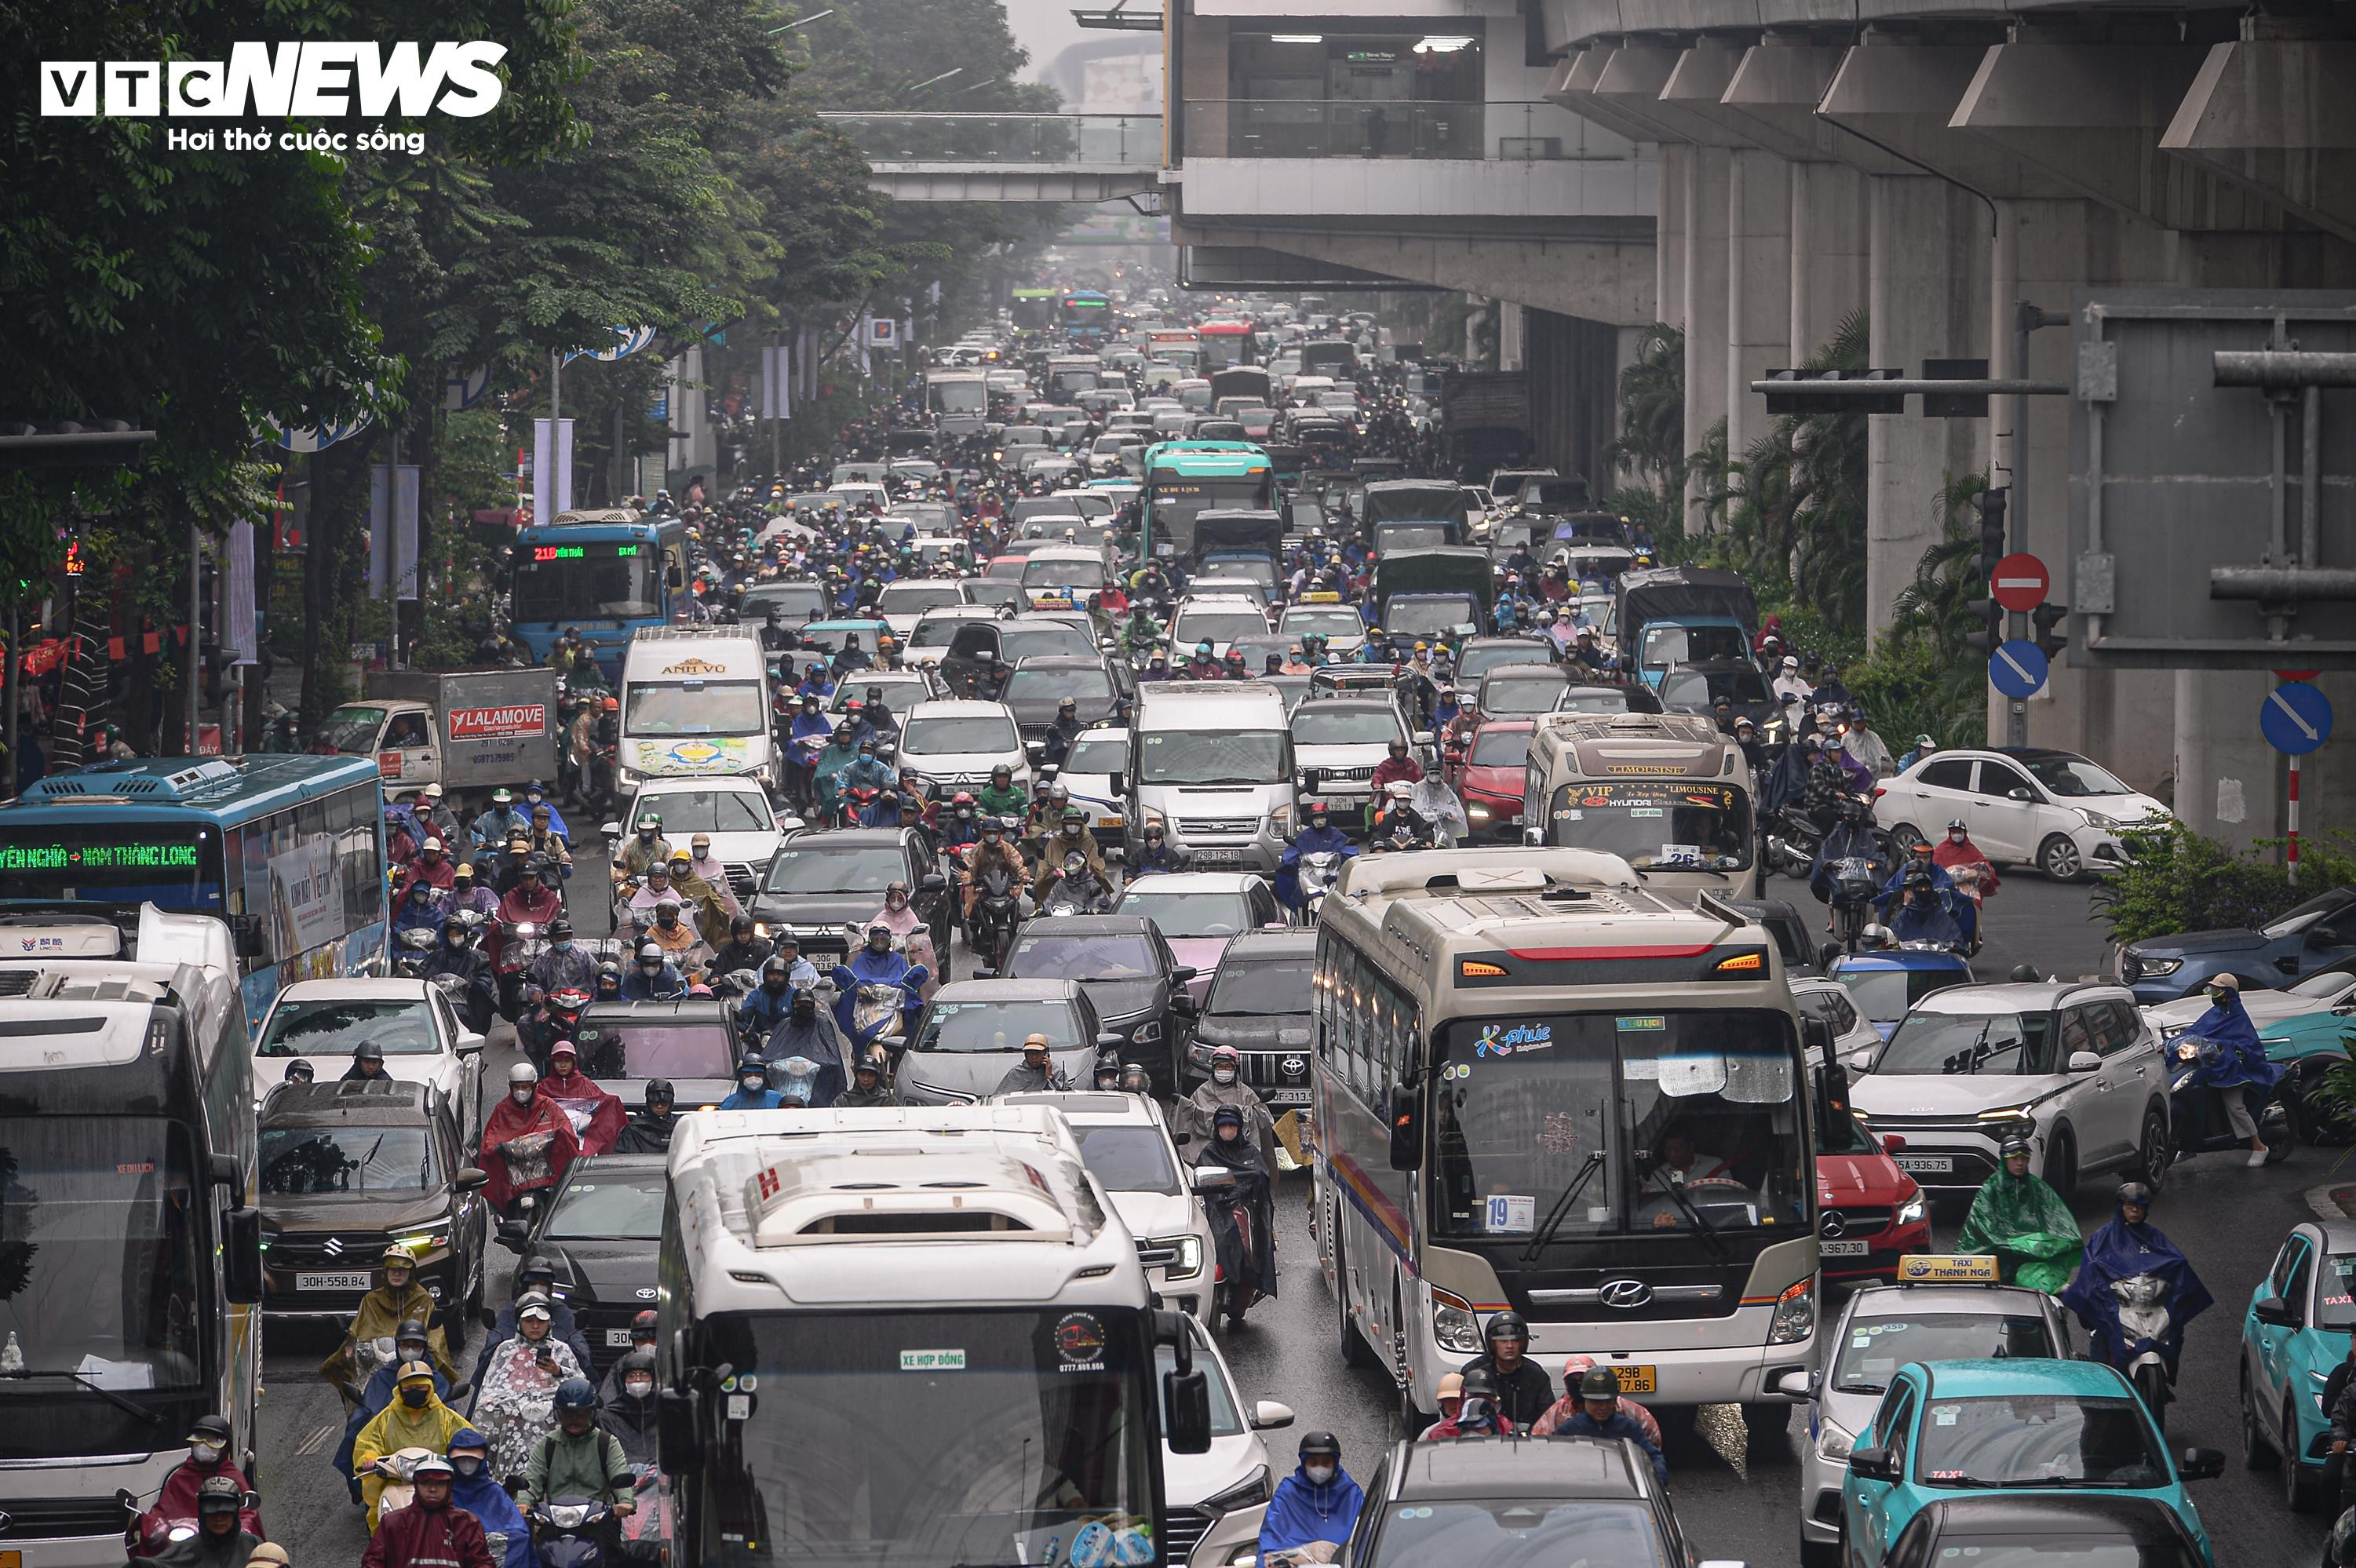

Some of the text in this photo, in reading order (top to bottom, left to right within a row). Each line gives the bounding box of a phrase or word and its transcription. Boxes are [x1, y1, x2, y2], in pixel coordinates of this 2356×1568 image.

[466, 707, 542, 727] LALAMOVE
[1611, 766, 1682, 775] LIMOUSINE
[1586, 786, 1719, 797] VIP LIMOUSINE
[27, 844, 67, 868] NGHĨA
[82, 846, 112, 866] NAM
[115, 842, 159, 866] THĂNG
[161, 845, 196, 866] LONG
[1198, 851, 1238, 860] 29B-125.18
[1671, 852, 1694, 866] 26
[1895, 1161, 1947, 1170] 5A-936.75
[1488, 1198, 1508, 1227] 19
[1934, 1268, 1967, 1277] THANH
[1971, 1267, 1991, 1277] NGA
[302, 1276, 365, 1287] 30H-558.84
[2323, 1295, 2353, 1306] TAXI
[903, 1355, 914, 1366] XE
[917, 1354, 935, 1368] HỢP
[1617, 1367, 1640, 1378] 29B
[1932, 1470, 1964, 1479] TAXI
